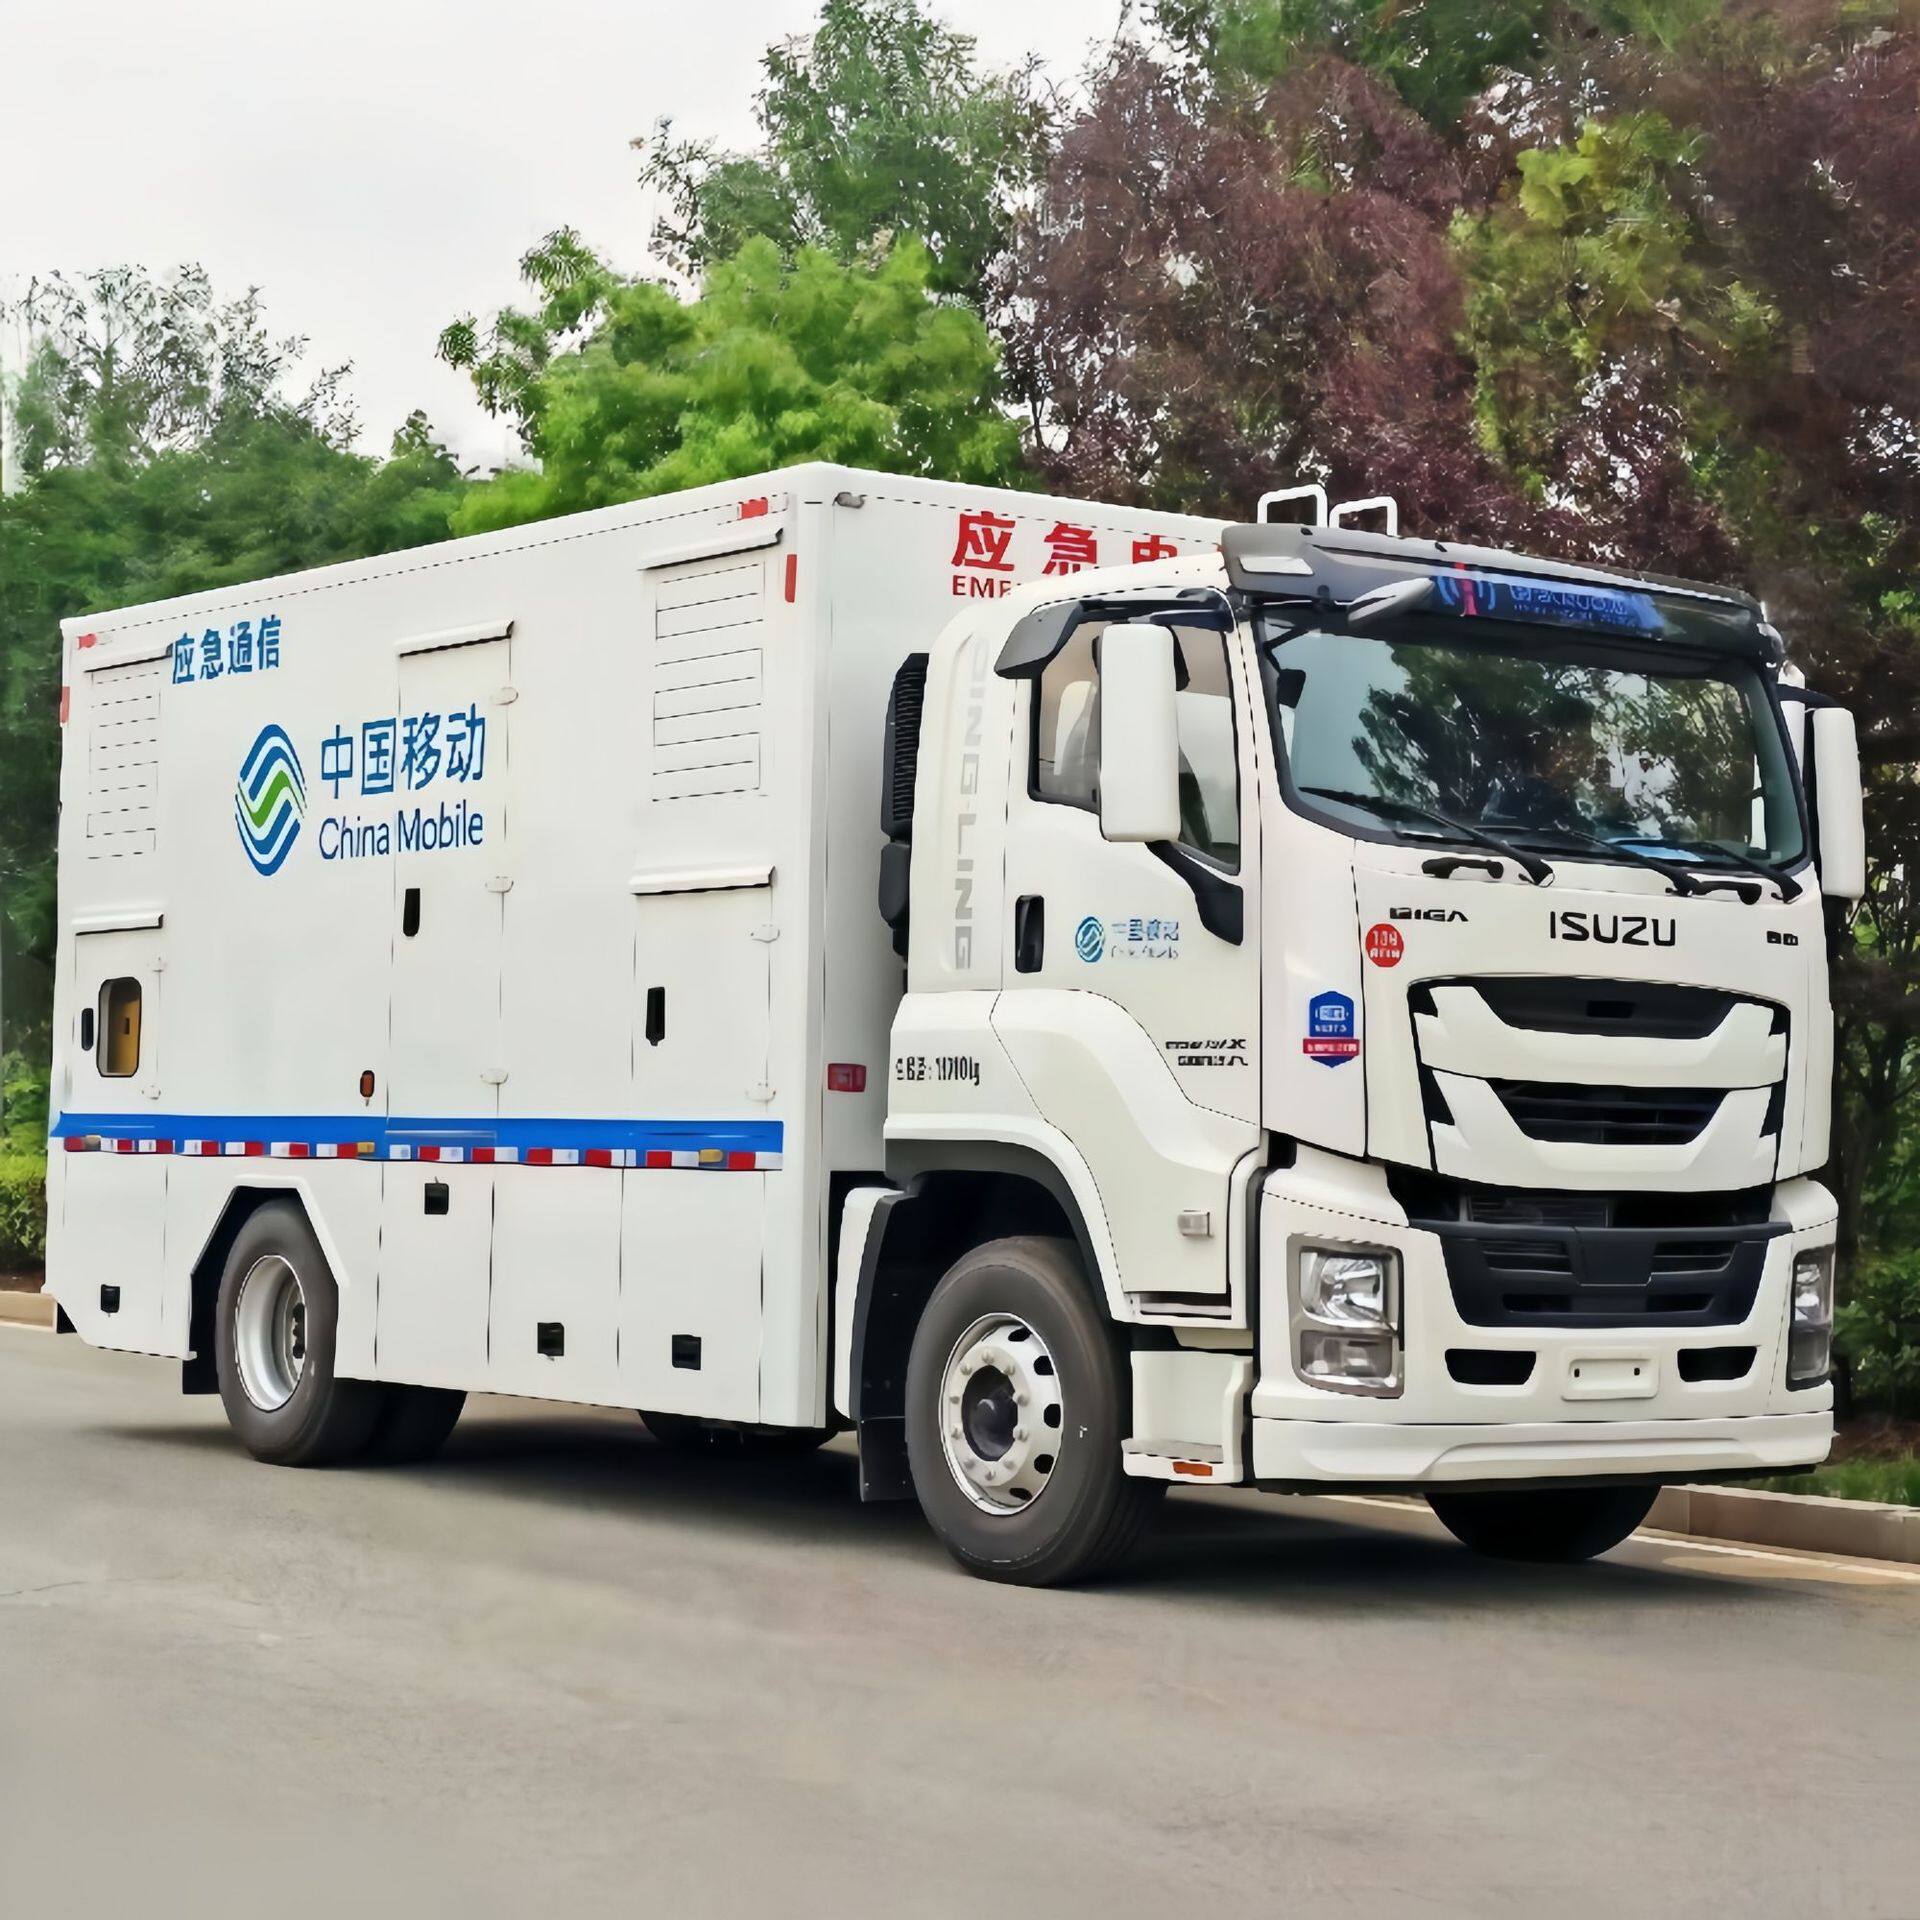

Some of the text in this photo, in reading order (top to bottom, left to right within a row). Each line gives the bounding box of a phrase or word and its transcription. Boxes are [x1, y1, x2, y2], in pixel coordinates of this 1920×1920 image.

[172, 614, 281, 684] 应急通信
[320, 703, 486, 799] 中国移动
[319, 798, 484, 860] China Mobile
[1549, 910, 1676, 947] ISUZU
